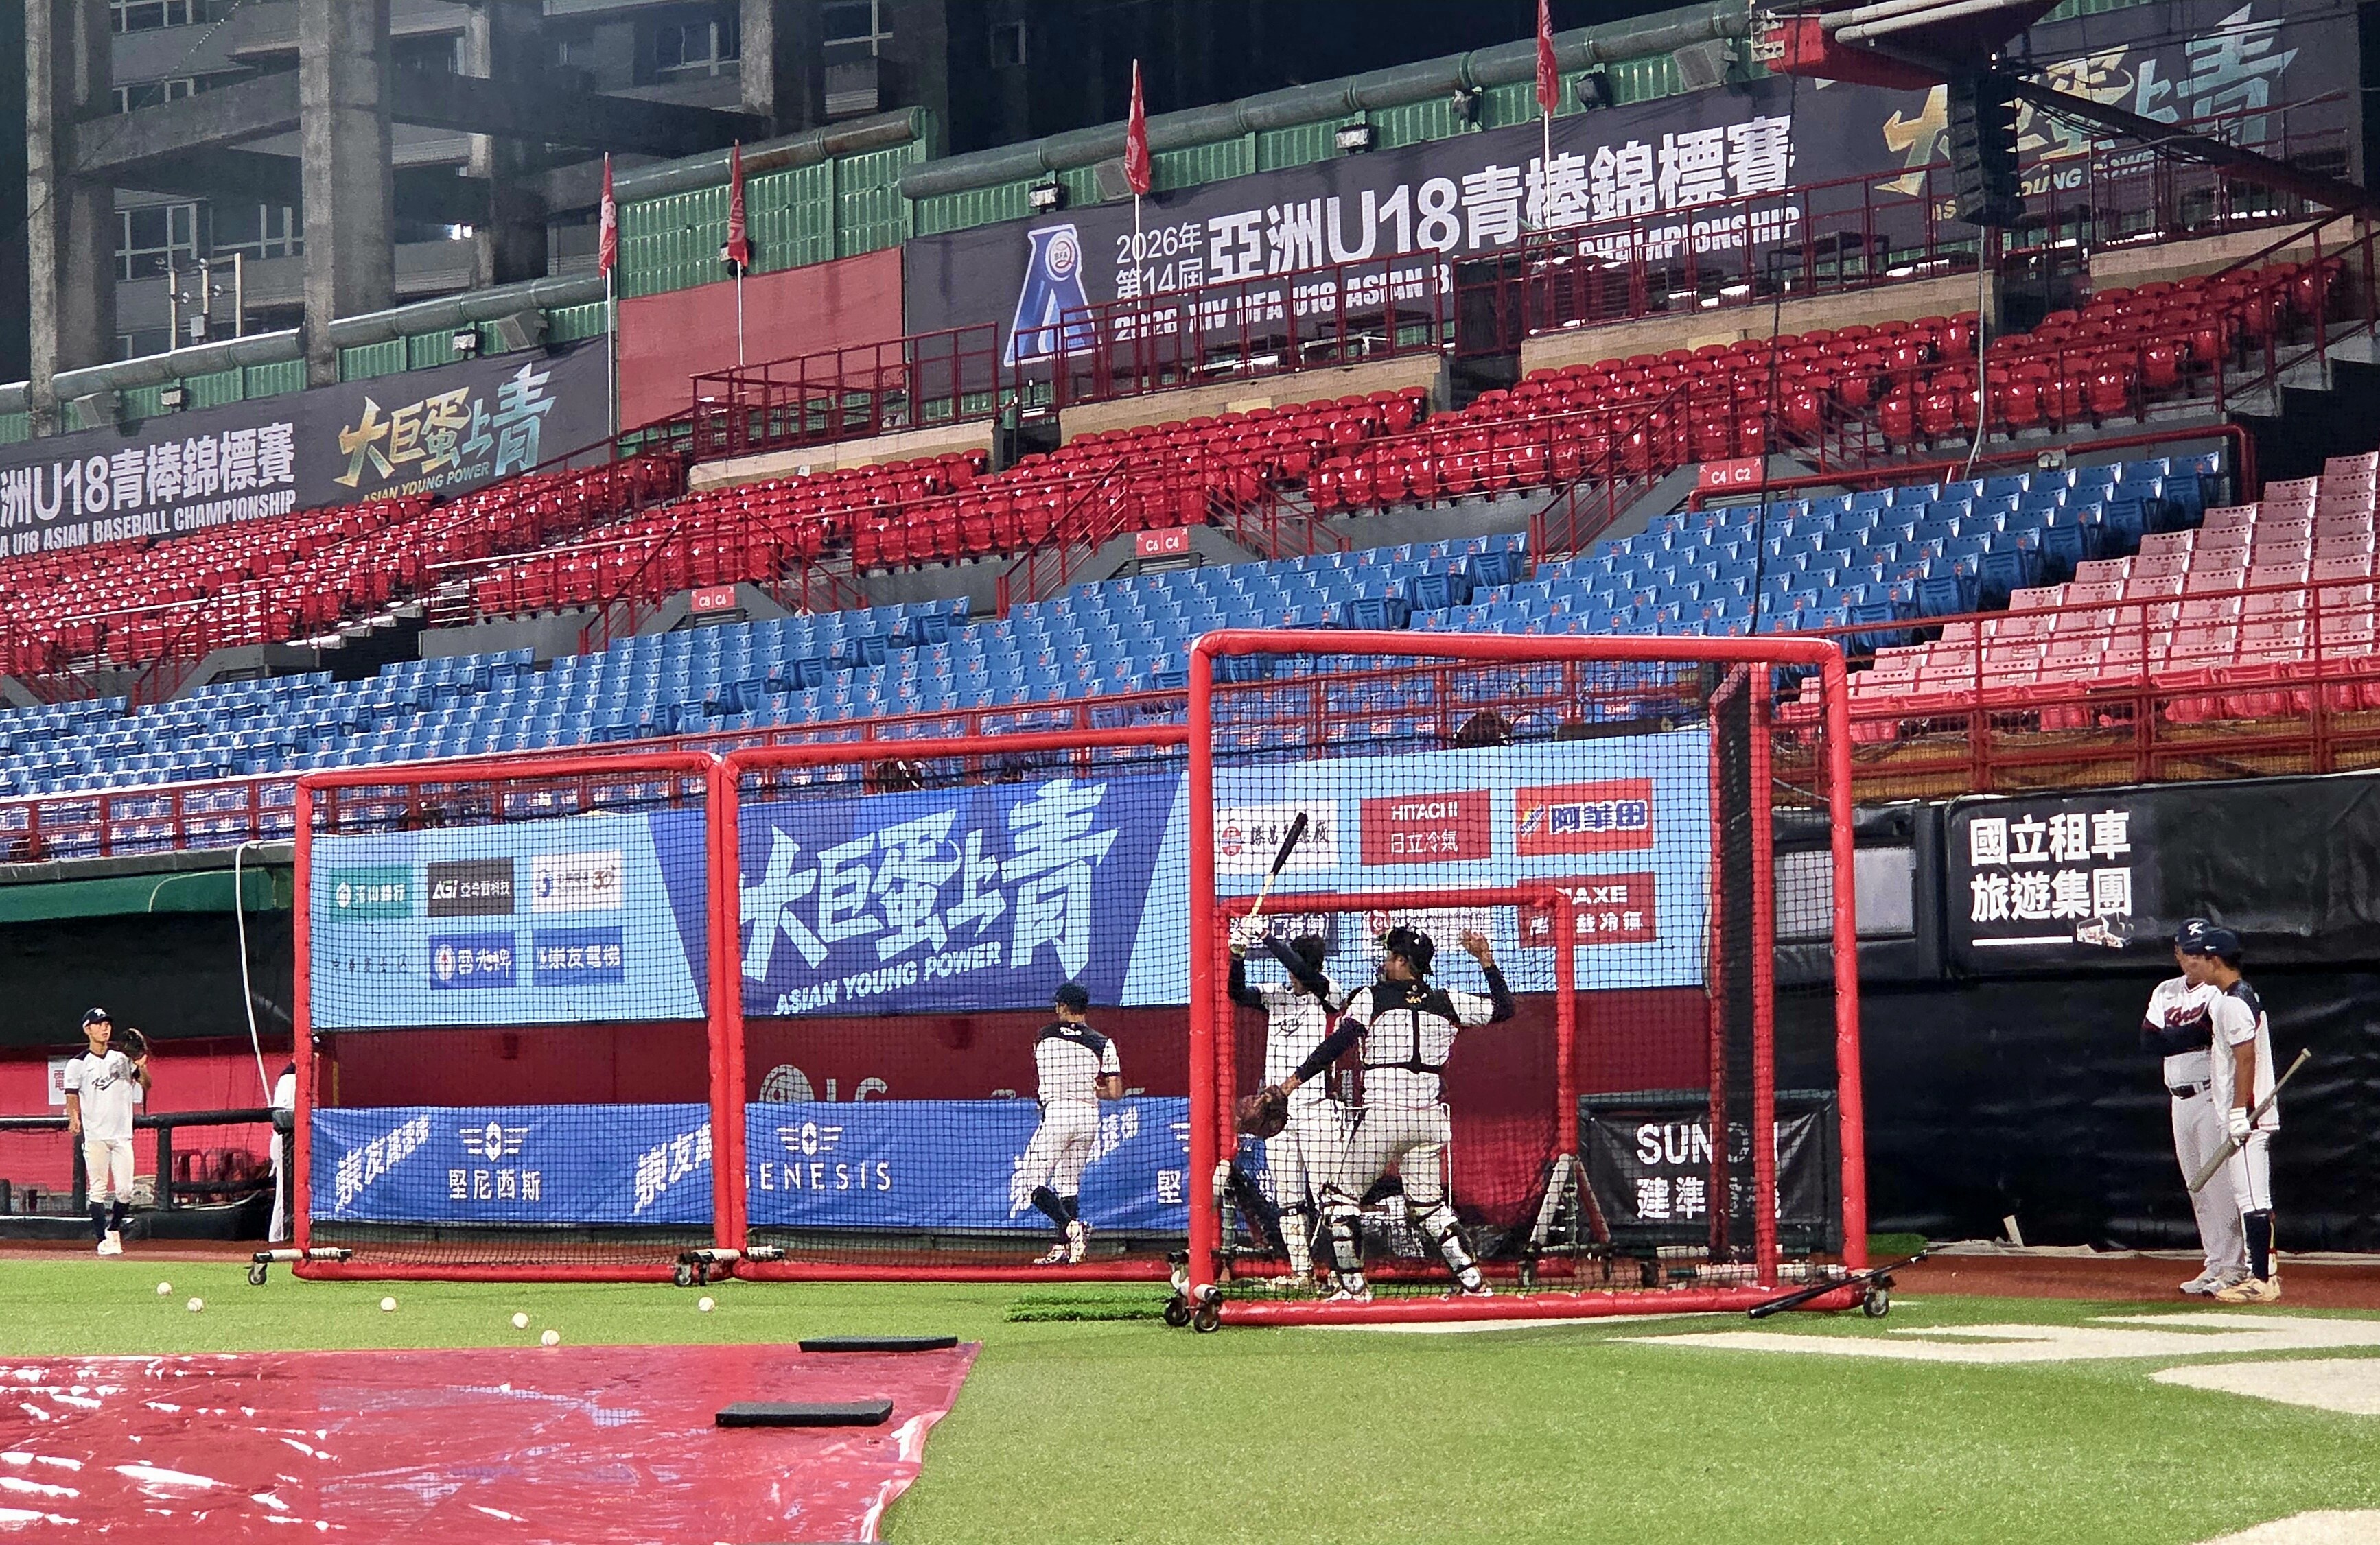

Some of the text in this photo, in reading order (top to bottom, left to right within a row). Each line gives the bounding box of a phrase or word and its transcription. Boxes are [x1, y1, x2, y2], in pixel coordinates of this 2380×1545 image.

[1208, 115, 1795, 285] 亞洲U18青棒錦標賽
[2016, 165, 2082, 198] OUNG
[1116, 222, 1202, 264] 2026年
[1116, 257, 1203, 307] 第14屆
[1293, 282, 1337, 316] U18
[402, 473, 443, 495] YOUNG
[446, 462, 490, 485] POWER
[1735, 467, 1751, 482] C2
[12, 530, 38, 556] U18
[44, 521, 88, 551] ASIAN
[93, 509, 170, 542] BASEBALL
[174, 489, 296, 530] CHAMPIONSHIP
[1146, 539, 1158, 552] C6
[1391, 801, 1458, 820] HITACHI
[1549, 800, 1647, 834] 阿華田
[1391, 829, 1458, 853] 日立冷氣
[1970, 809, 2131, 866] 國立租車
[1970, 867, 2132, 923] 旅遊集團
[773, 941, 1001, 1016] ASIAN YOUNG POWER
[1636, 1123, 1779, 1165] SUNO
